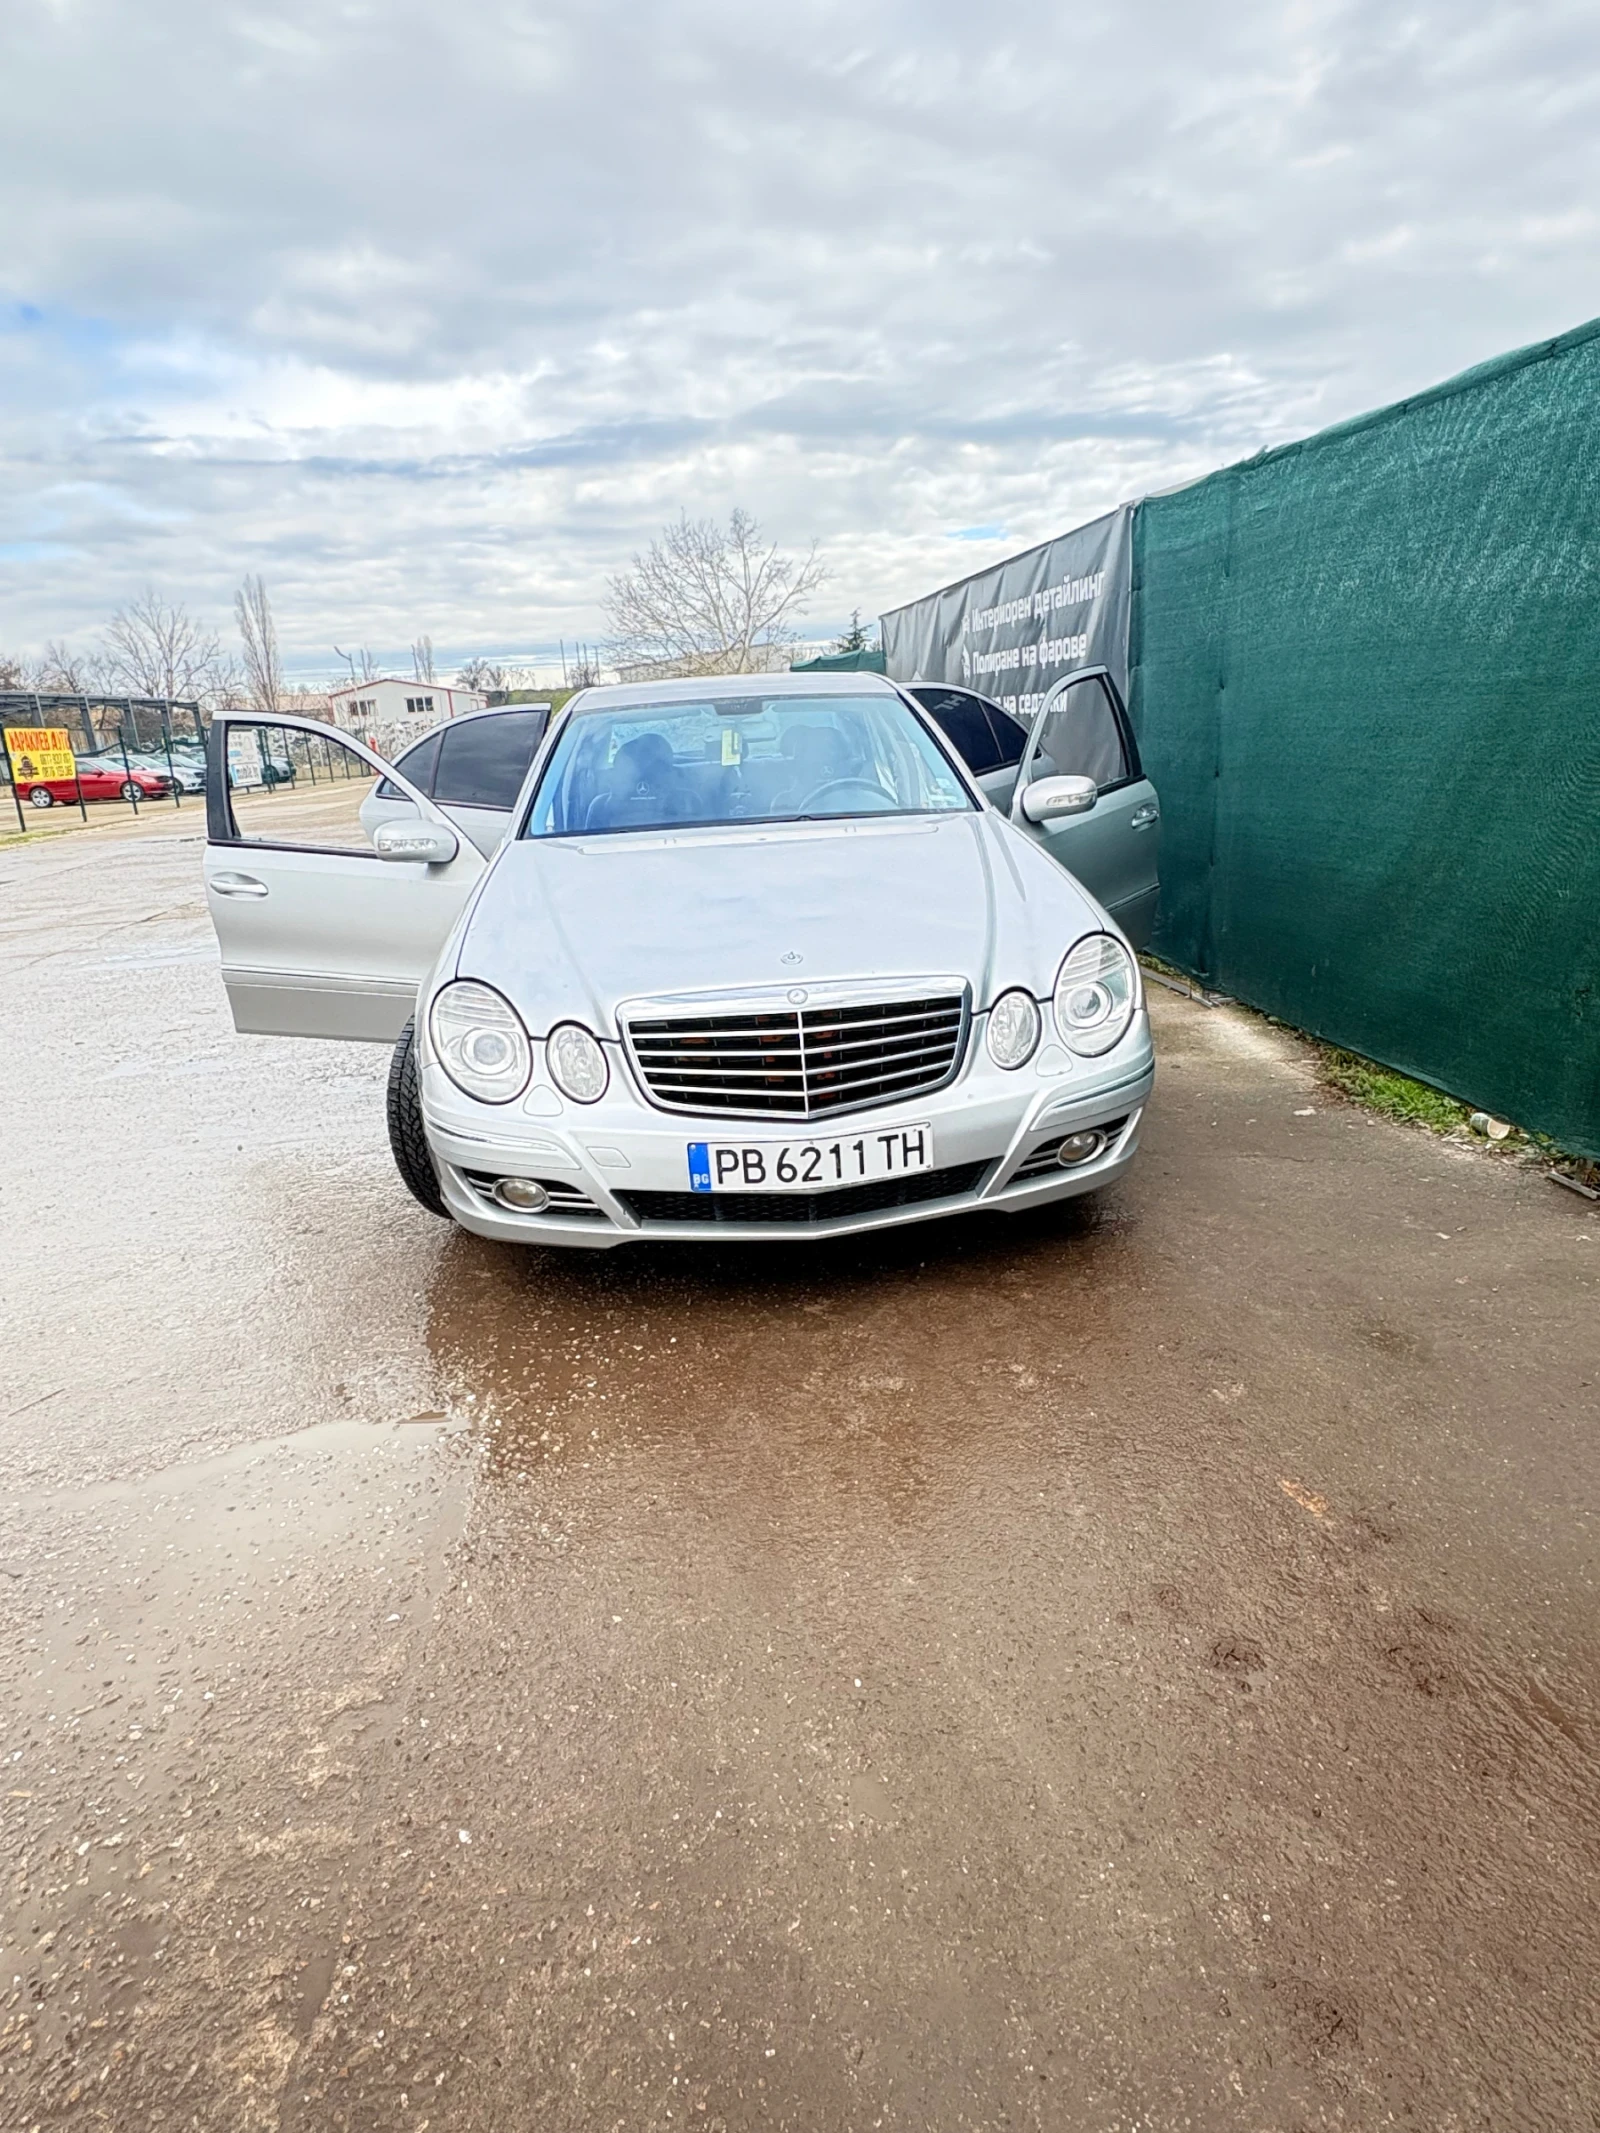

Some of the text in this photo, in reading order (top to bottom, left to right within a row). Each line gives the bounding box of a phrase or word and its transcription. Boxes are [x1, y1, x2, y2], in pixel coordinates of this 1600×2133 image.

[972, 571, 1105, 633] Интериорен детайлинг
[973, 634, 1087, 676] Полиране на фарове
[693, 1174, 710, 1184] BG
[716, 1130, 924, 1184] PB 6211 TH
